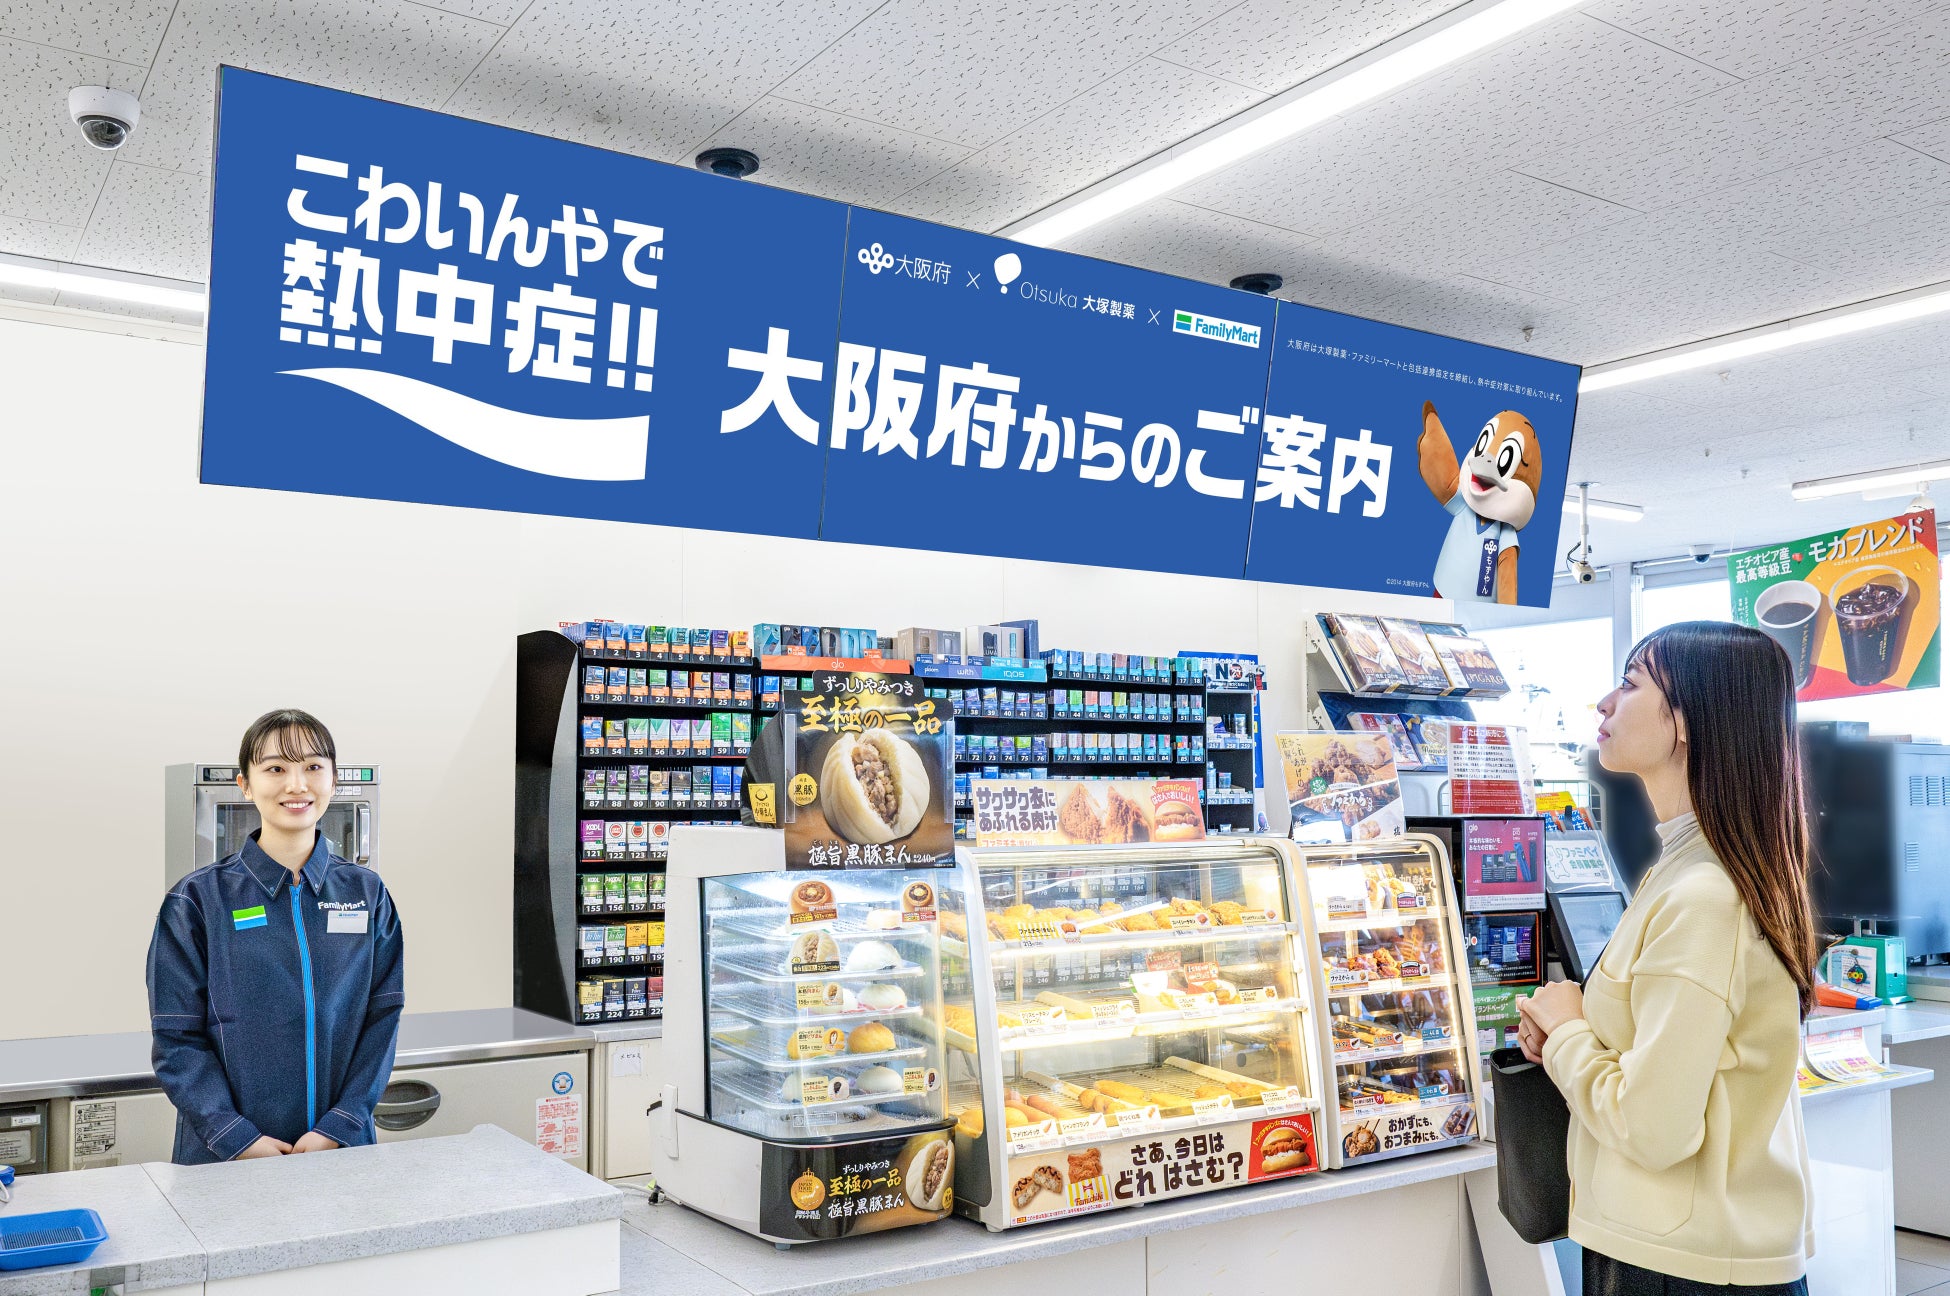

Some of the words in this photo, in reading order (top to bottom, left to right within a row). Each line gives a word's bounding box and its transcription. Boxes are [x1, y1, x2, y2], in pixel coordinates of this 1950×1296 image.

[287, 154, 665, 290] こわいんやで
[894, 256, 952, 286] 大阪府
[1020, 280, 1078, 309] Otsuka
[1082, 294, 1136, 320] 大塚製薬
[1195, 318, 1259, 345] FamilyMart
[280, 238, 658, 393] 熱中症!!
[720, 326, 1394, 518] 大阪府からのご案内
[1808, 516, 1924, 563] モカブレンド
[1736, 548, 1790, 570] エチオピア産
[1482, 556, 1492, 594] もずやん
[1736, 558, 1792, 584] 最高等級豆
[831, 658, 844, 670] glo
[822, 676, 914, 696] ずっしりやみつき
[799, 694, 942, 735] 至極の一品
[794, 784, 813, 796] 黒豚
[976, 786, 1056, 810] サクサク衣に
[754, 807, 773, 817] 中華まん
[979, 811, 1058, 832] あふれる肉汁
[1469, 823, 1478, 833] glo
[808, 844, 910, 865] 極旨黒豚まん
[1562, 846, 1599, 858] ファミペイ
[318, 900, 366, 911] FamilyMart
[1388, 1115, 1433, 1132] おかずにも、
[1130, 1131, 1225, 1166] さあ、今日は
[1384, 1130, 1439, 1148] おつまみにも。
[843, 1160, 890, 1175] ずっしりやみつき
[1114, 1168, 1156, 1199] どれ
[1164, 1152, 1243, 1192] はさむ?
[828, 1168, 902, 1197] 至極の一品
[828, 1193, 905, 1218] 極旨黒豚まん
[1075, 1191, 1104, 1206] Famichiki
